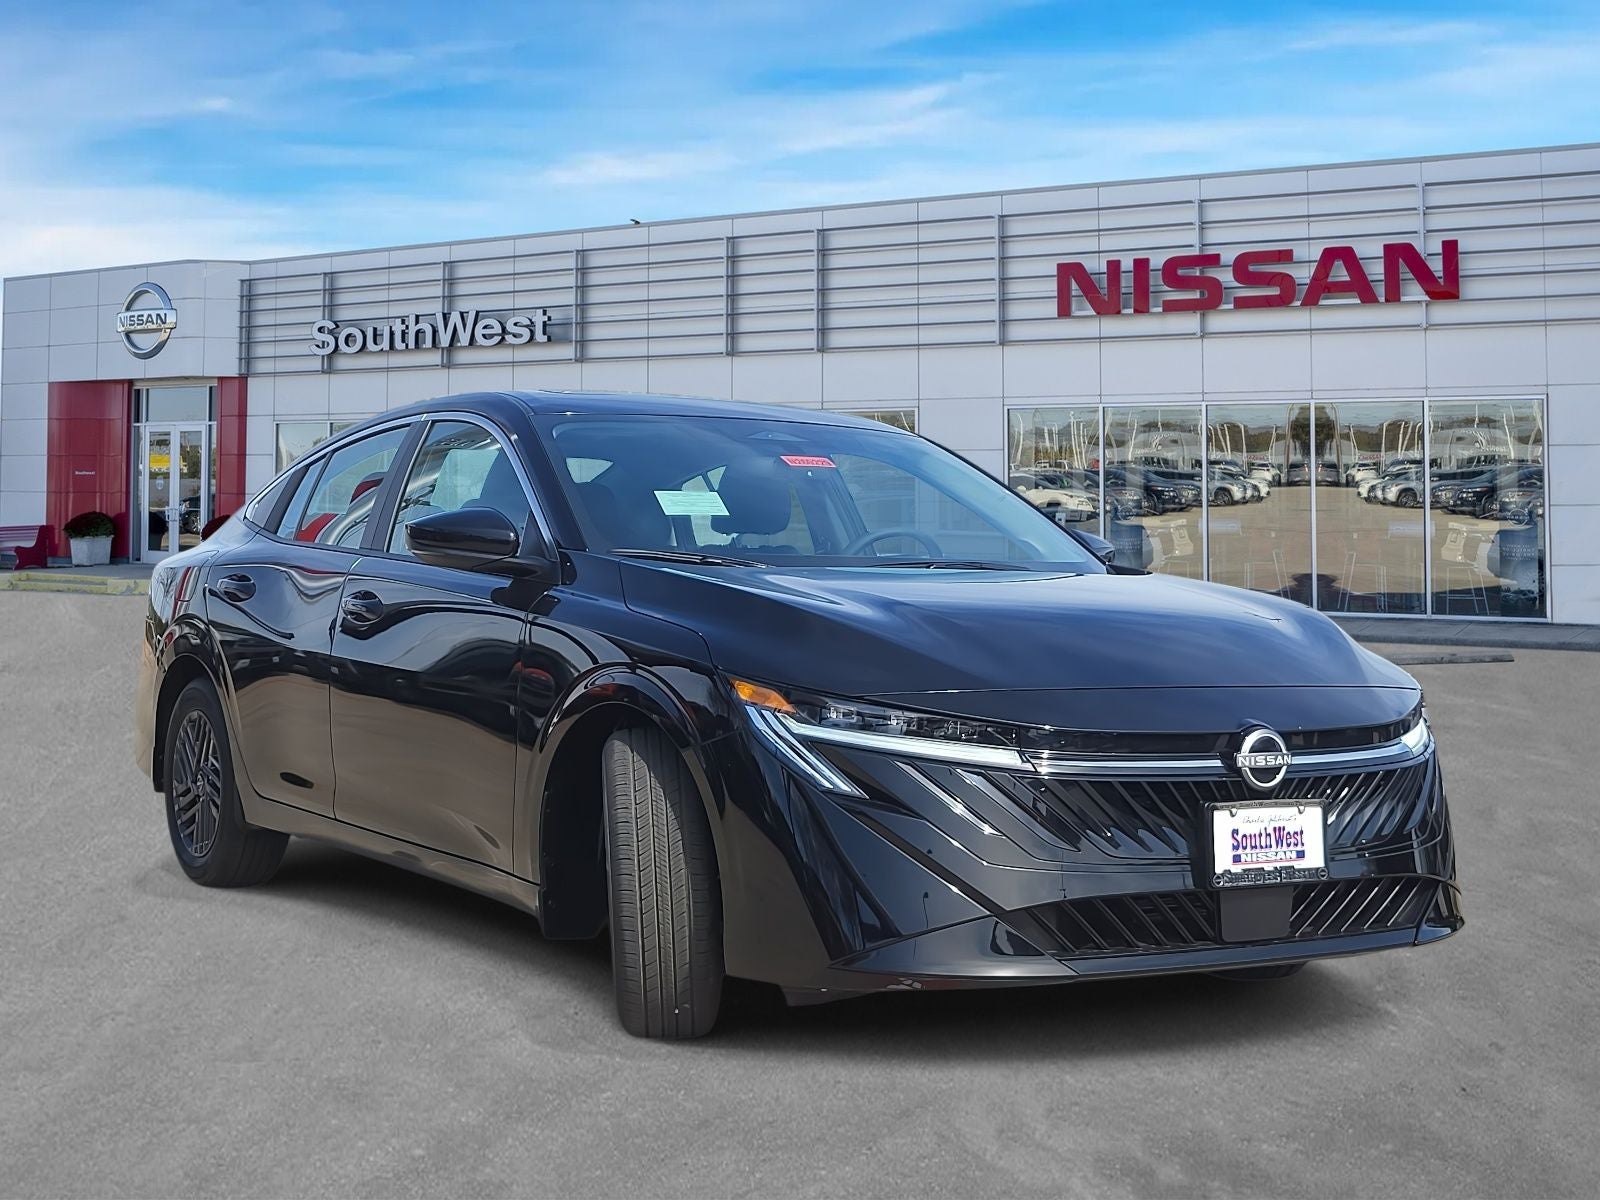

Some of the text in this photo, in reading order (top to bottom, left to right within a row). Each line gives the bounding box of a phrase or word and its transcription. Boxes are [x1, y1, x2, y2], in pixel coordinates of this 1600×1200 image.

[1056, 239, 1460, 318] NISSAN
[119, 313, 168, 328] NISSAN
[309, 308, 551, 355] SouthWest
[1238, 754, 1292, 766] NISSAN
[1240, 850, 1297, 863] NISSAN
